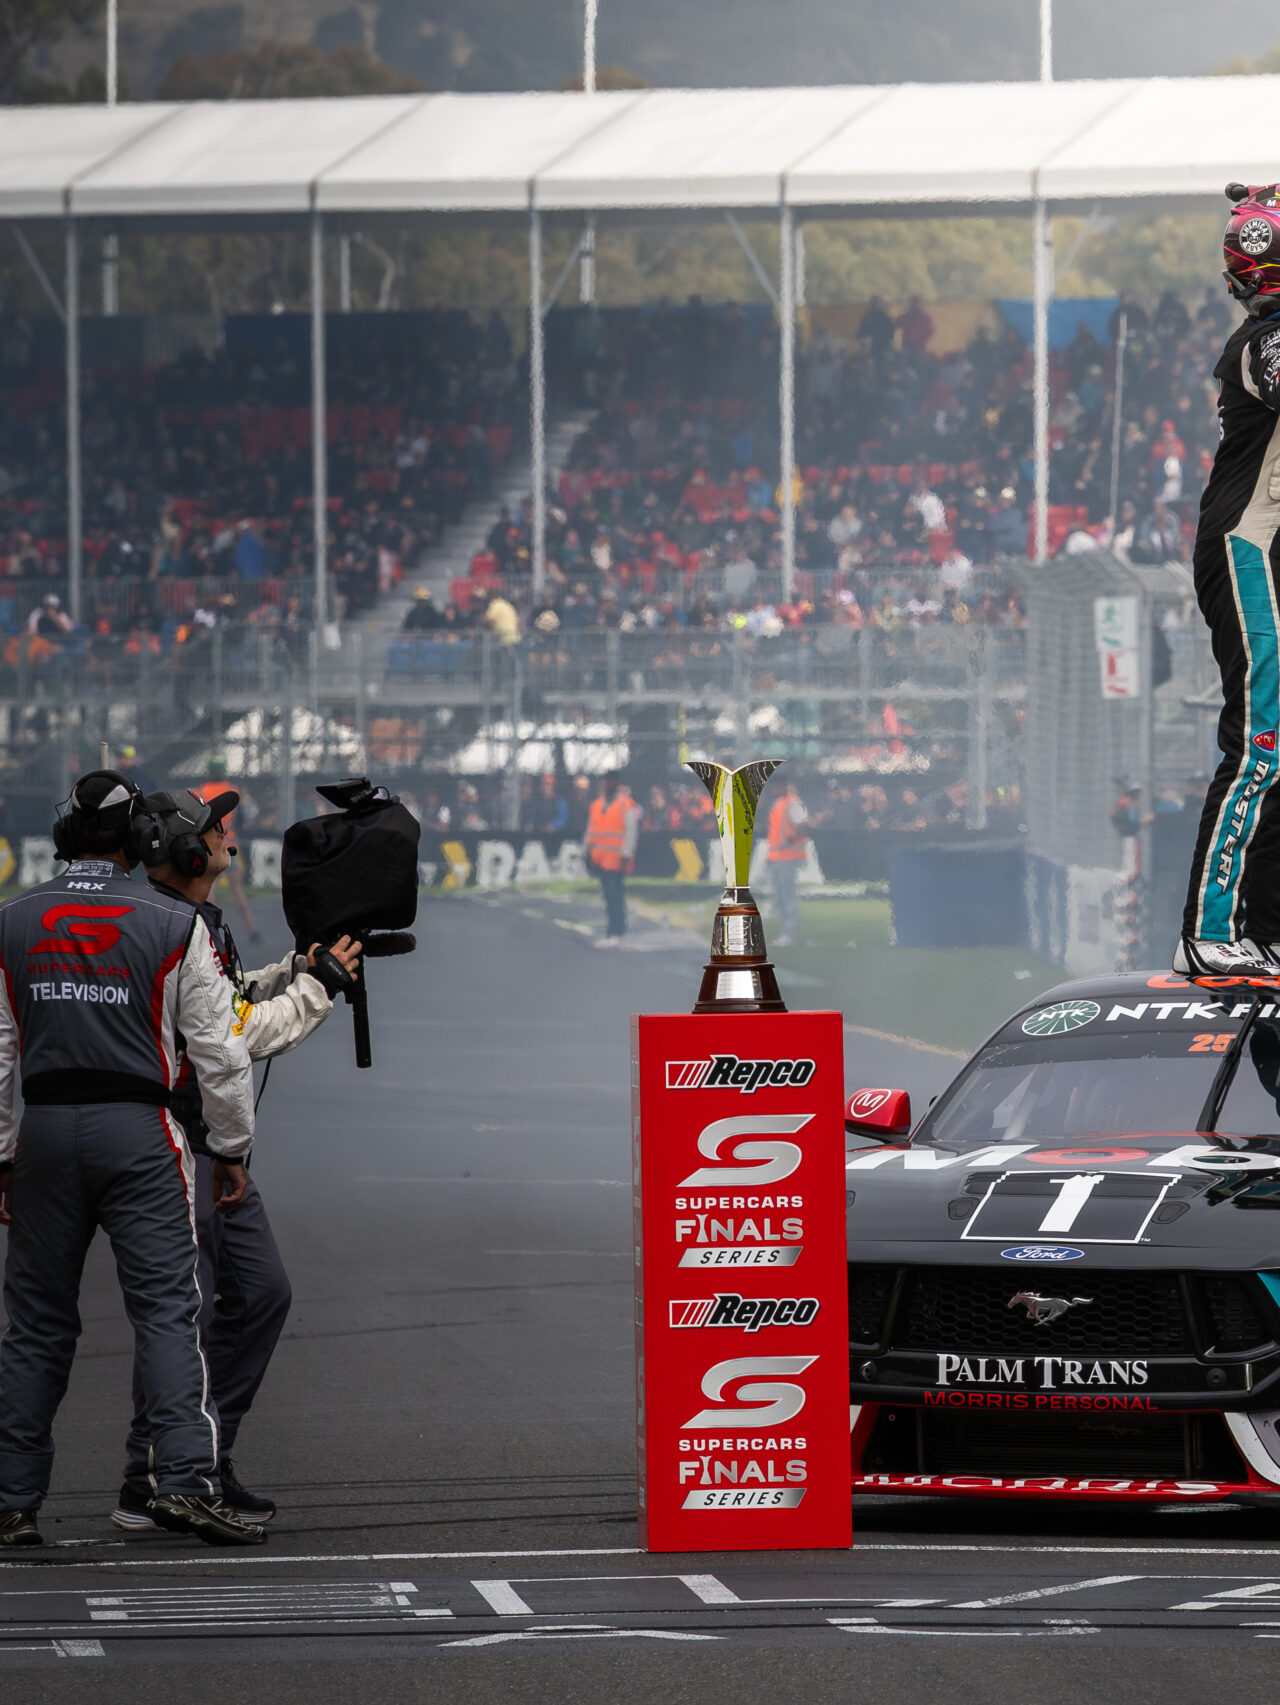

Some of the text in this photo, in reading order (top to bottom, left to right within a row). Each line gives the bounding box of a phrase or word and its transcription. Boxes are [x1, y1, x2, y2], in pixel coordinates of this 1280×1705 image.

[1242, 218, 1270, 238] CHEMICAL
[1245, 242, 1264, 253] GUYS
[66, 881, 107, 890] HRX
[26, 962, 131, 979] SUPERCARS
[30, 982, 130, 1005] TELEVISION
[1039, 1006, 1090, 1021] NTK
[1105, 1002, 1225, 1021] NTK
[1188, 1034, 1236, 1052] 25
[702, 1054, 817, 1093] Repco
[675, 1195, 803, 1210] SUPERCARS
[675, 1213, 804, 1243] FINALS
[700, 1250, 781, 1264] SERIES
[1015, 1247, 1067, 1260] Ford
[704, 1293, 820, 1332] Repco
[935, 1353, 1150, 1389] PALM TRANS
[924, 1390, 1159, 1411] MORRIS PERSONAL
[678, 1437, 807, 1452] SUPERCARS
[678, 1455, 808, 1485] FINALS
[703, 1491, 785, 1506] SERIES
